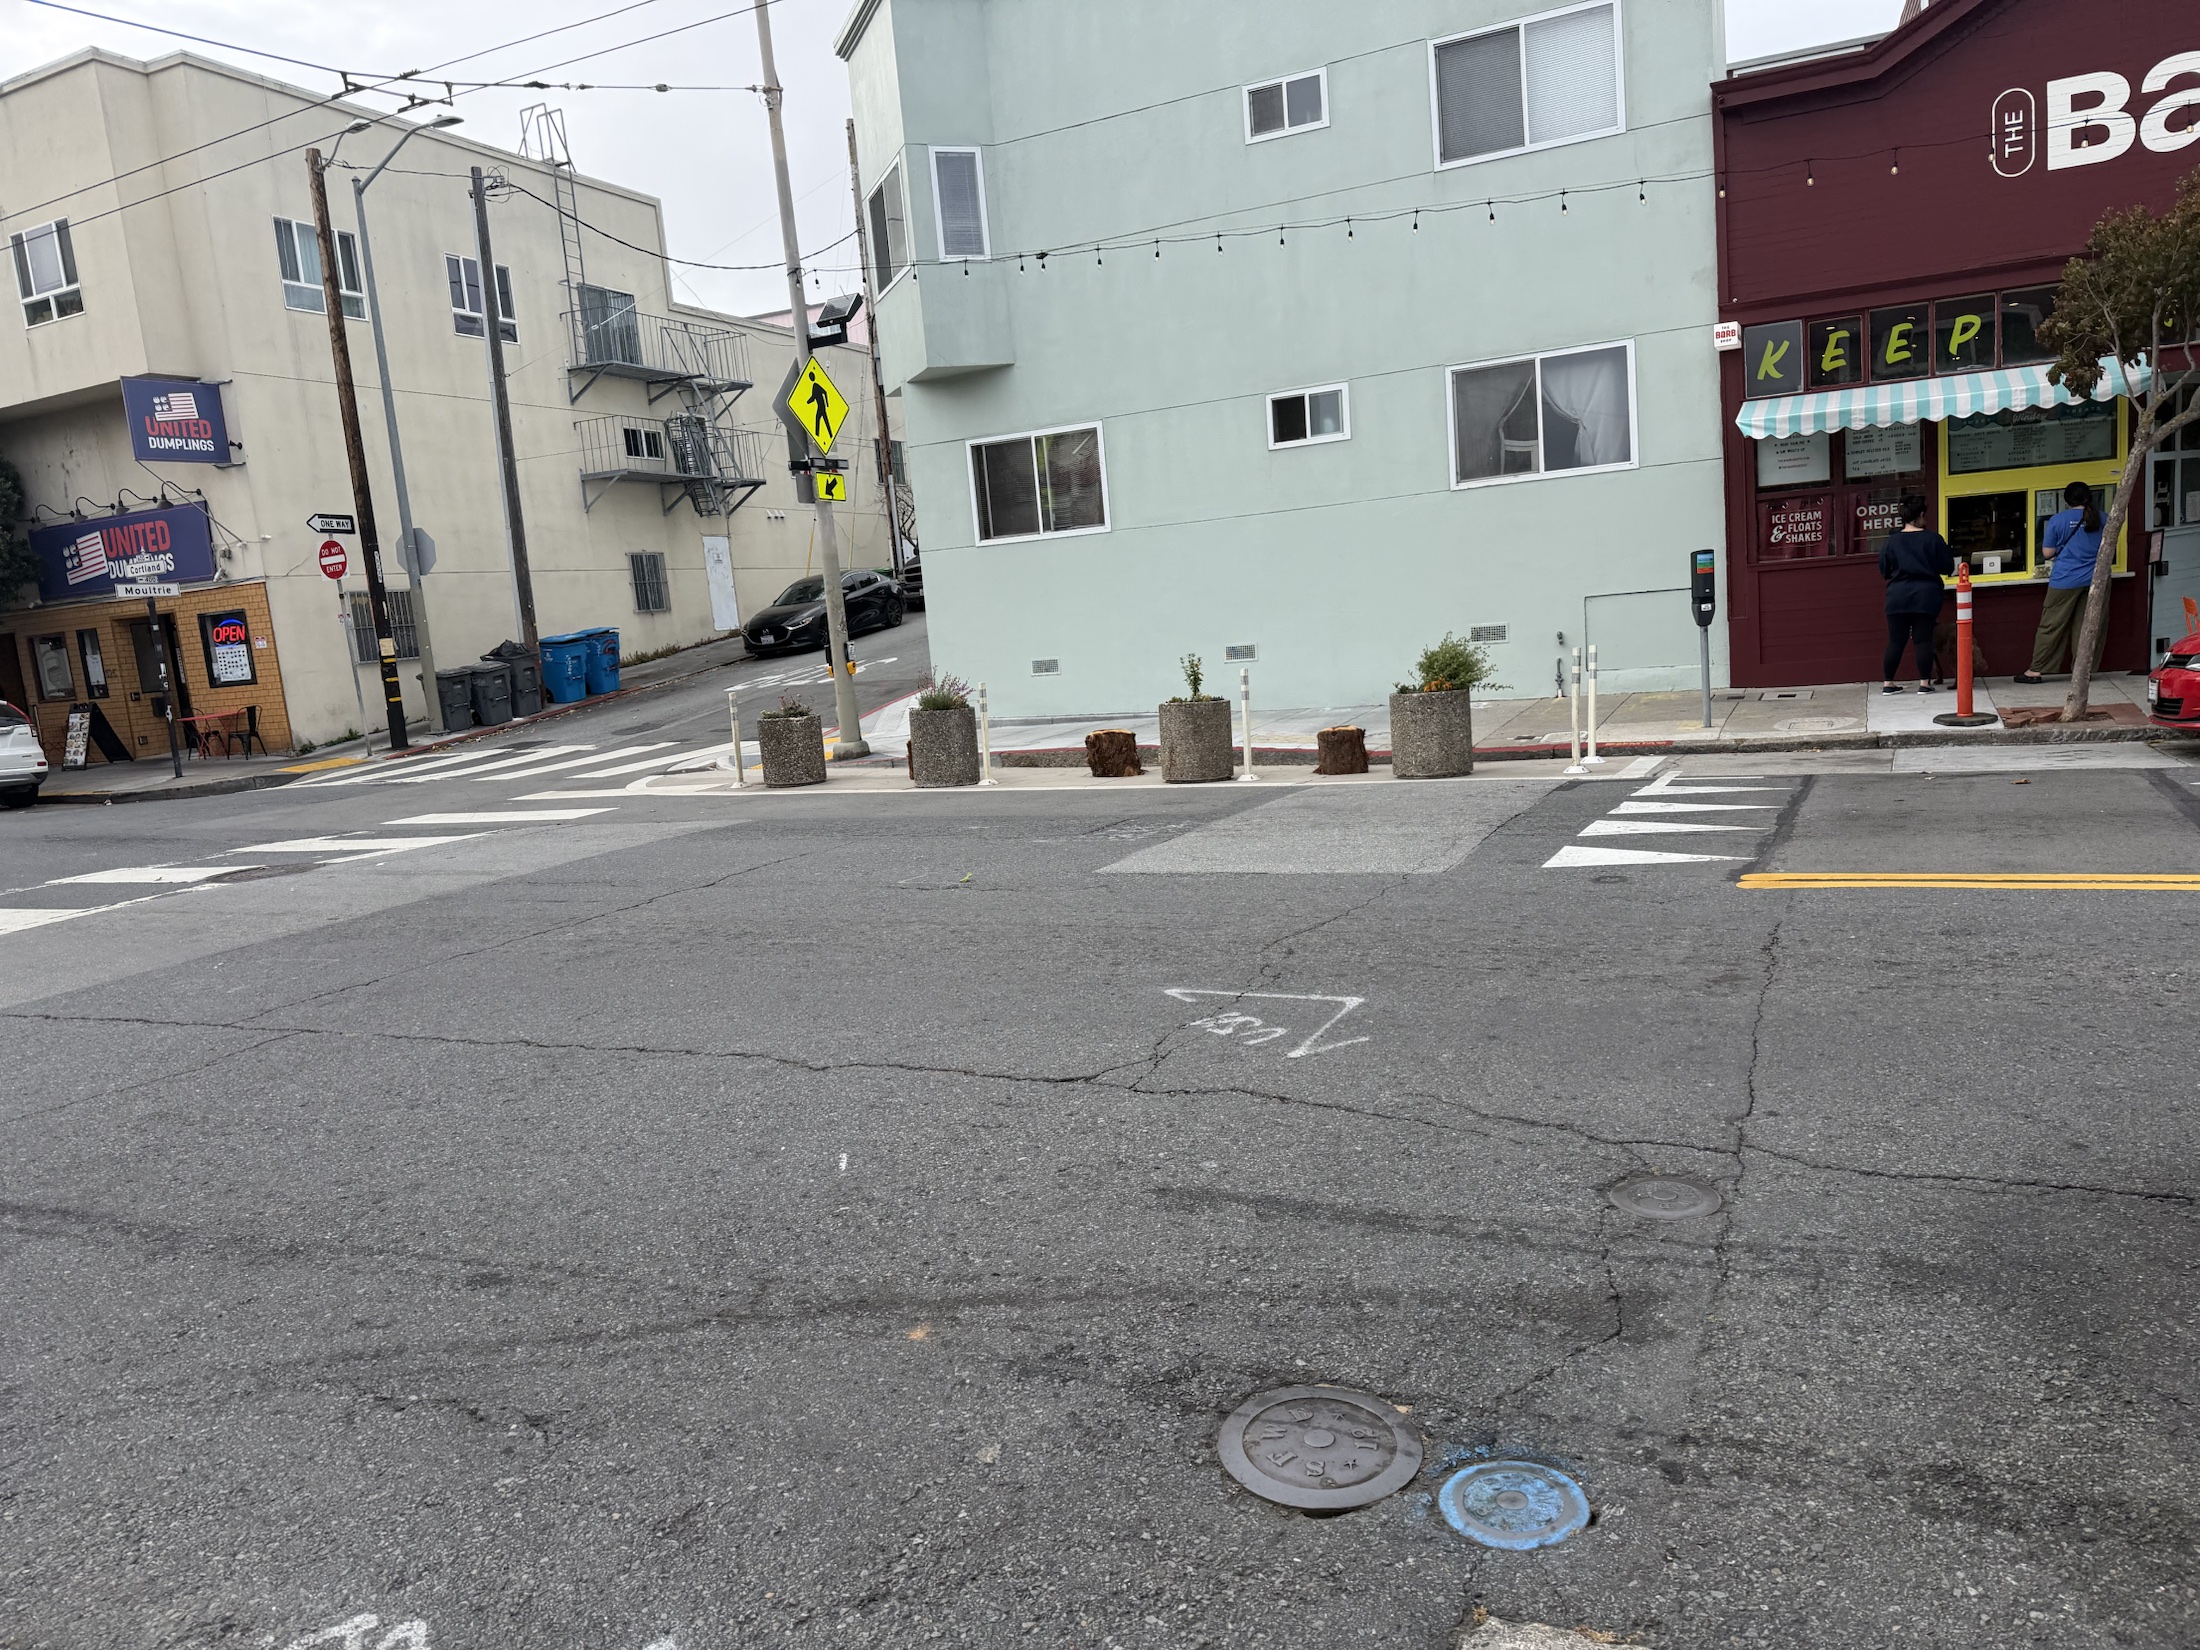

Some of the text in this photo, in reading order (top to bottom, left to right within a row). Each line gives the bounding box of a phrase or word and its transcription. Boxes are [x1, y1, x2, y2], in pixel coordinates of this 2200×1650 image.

[2005, 110, 2023, 159] THE
[144, 416, 212, 439] UNITED
[148, 437, 215, 452] DUMPLINGS
[1856, 502, 1904, 517] ORDE
[320, 520, 350, 528] ONE WAY
[1771, 510, 1822, 524] ICE CREAM
[1863, 517, 1903, 531] HERE
[102, 520, 171, 558] UNITED
[1770, 521, 1823, 543] & FLOATS
[1785, 531, 1823, 543] SHAKES
[331, 546, 341, 554] NOT
[130, 563, 161, 575] Cortland
[326, 564, 343, 573] ENTER
[125, 586, 172, 595] Moultrie
[213, 625, 246, 642] OPEN
